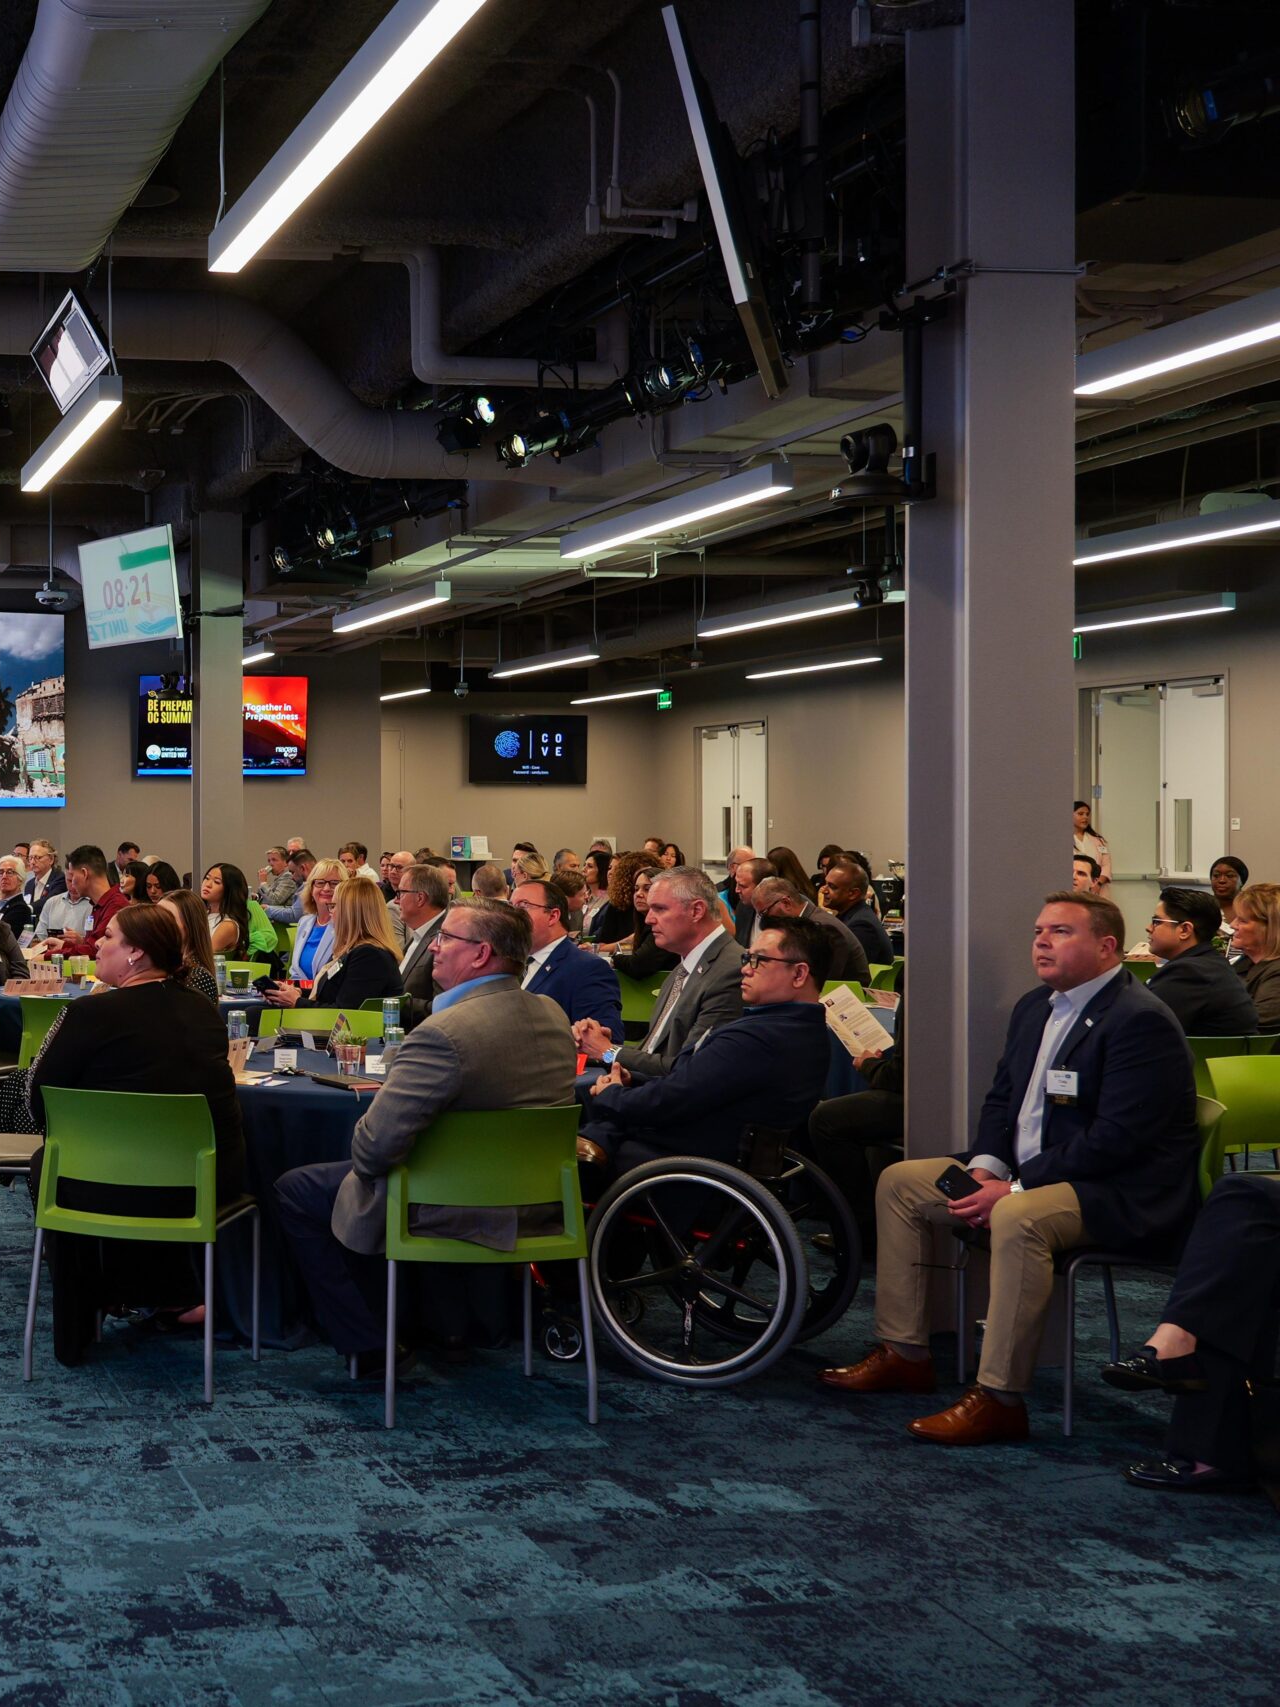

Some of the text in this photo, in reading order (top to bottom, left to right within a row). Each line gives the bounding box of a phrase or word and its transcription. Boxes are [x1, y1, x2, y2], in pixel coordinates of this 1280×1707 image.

[103, 572, 151, 610] 08:21
[147, 699, 159, 711] BE
[245, 703, 292, 713] Together in
[147, 712, 159, 724] OC
[245, 712, 299, 722] Preparedness
